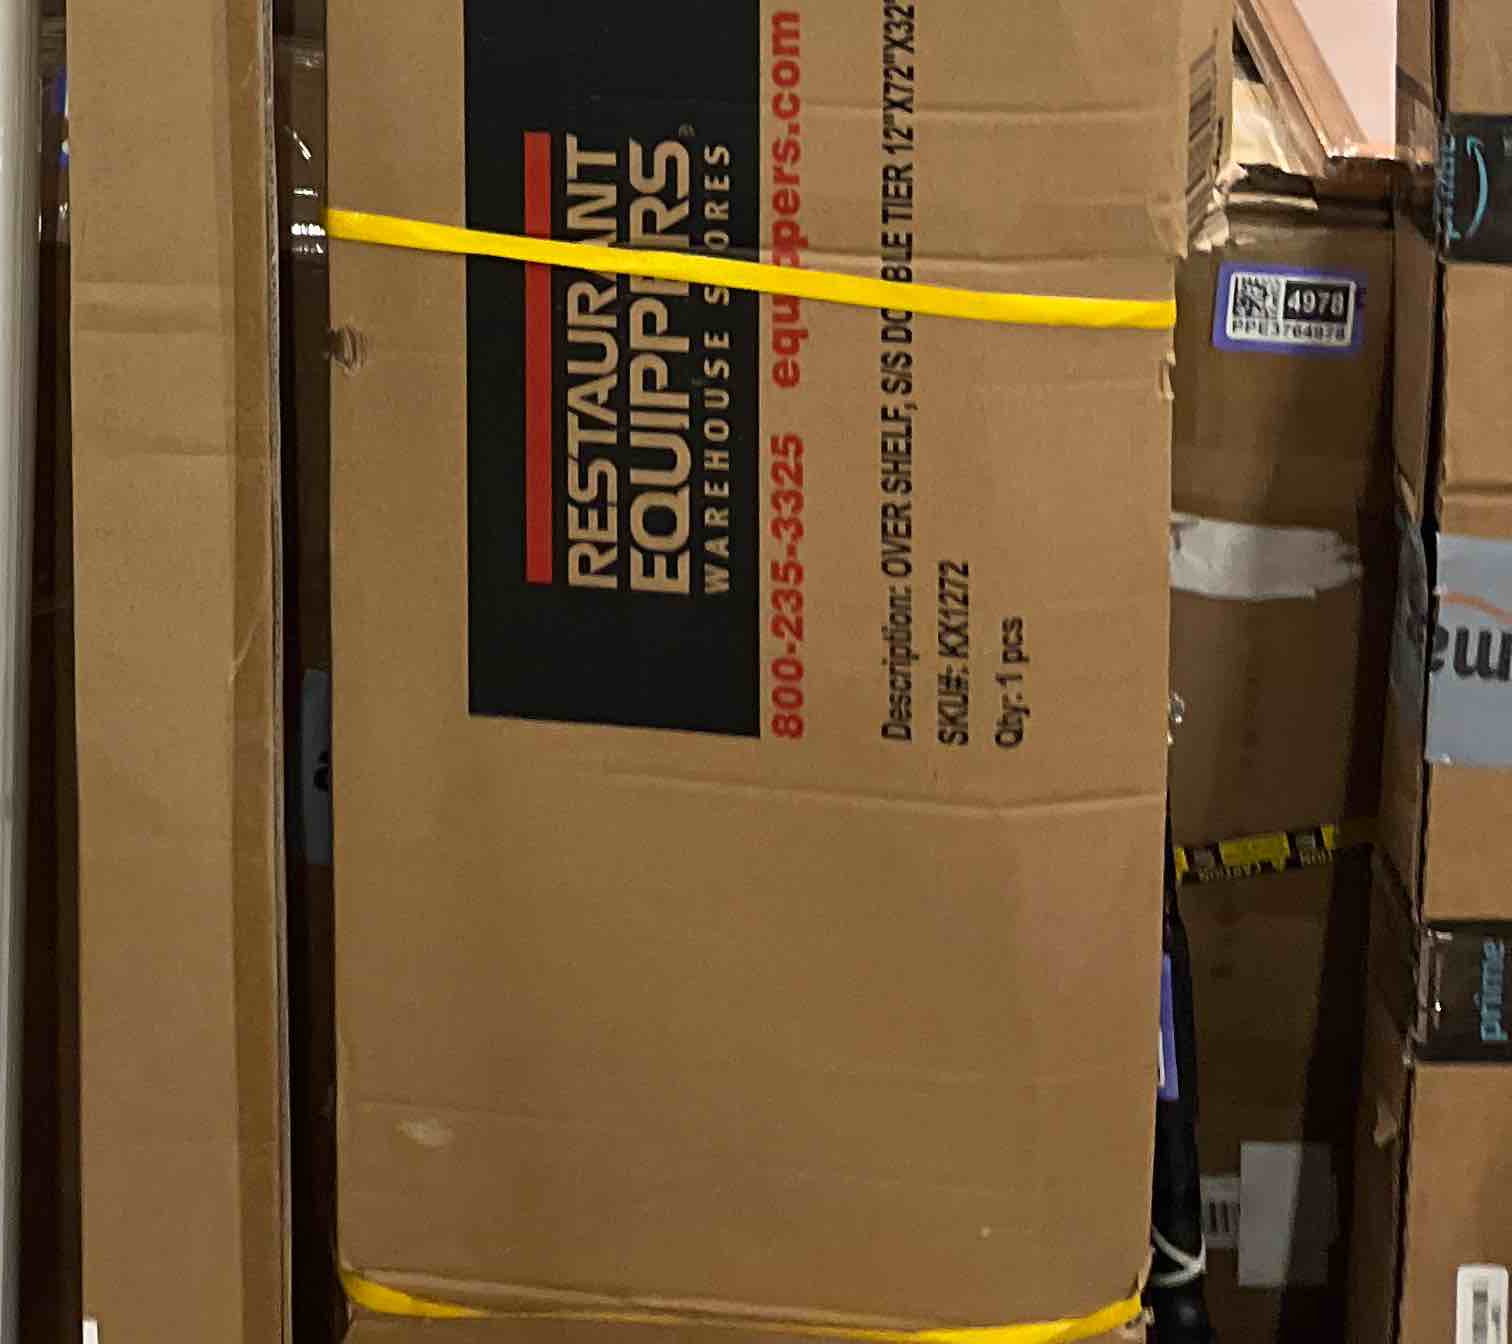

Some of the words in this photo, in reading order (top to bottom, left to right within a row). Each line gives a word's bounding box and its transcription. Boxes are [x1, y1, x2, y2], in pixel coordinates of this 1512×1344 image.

[703, 144, 731, 306] SORES
[772, 8, 809, 389] equppers.com
[881, 162, 914, 225] TIER
[881, 232, 914, 345] DOBLE
[1288, 289, 1345, 317] 4978
[881, 351, 913, 396] S/S
[703, 330, 731, 594] WAREHOUSE
[881, 401, 918, 497] SHELF,
[771, 432, 805, 739] 800-235-3325
[881, 502, 914, 580] OVER
[937, 559, 970, 660] KX1272
[1001, 616, 1030, 666] pcs
[881, 584, 920, 744] Description:
[937, 663, 970, 747] SKU#:
[995, 672, 1024, 687] 1
